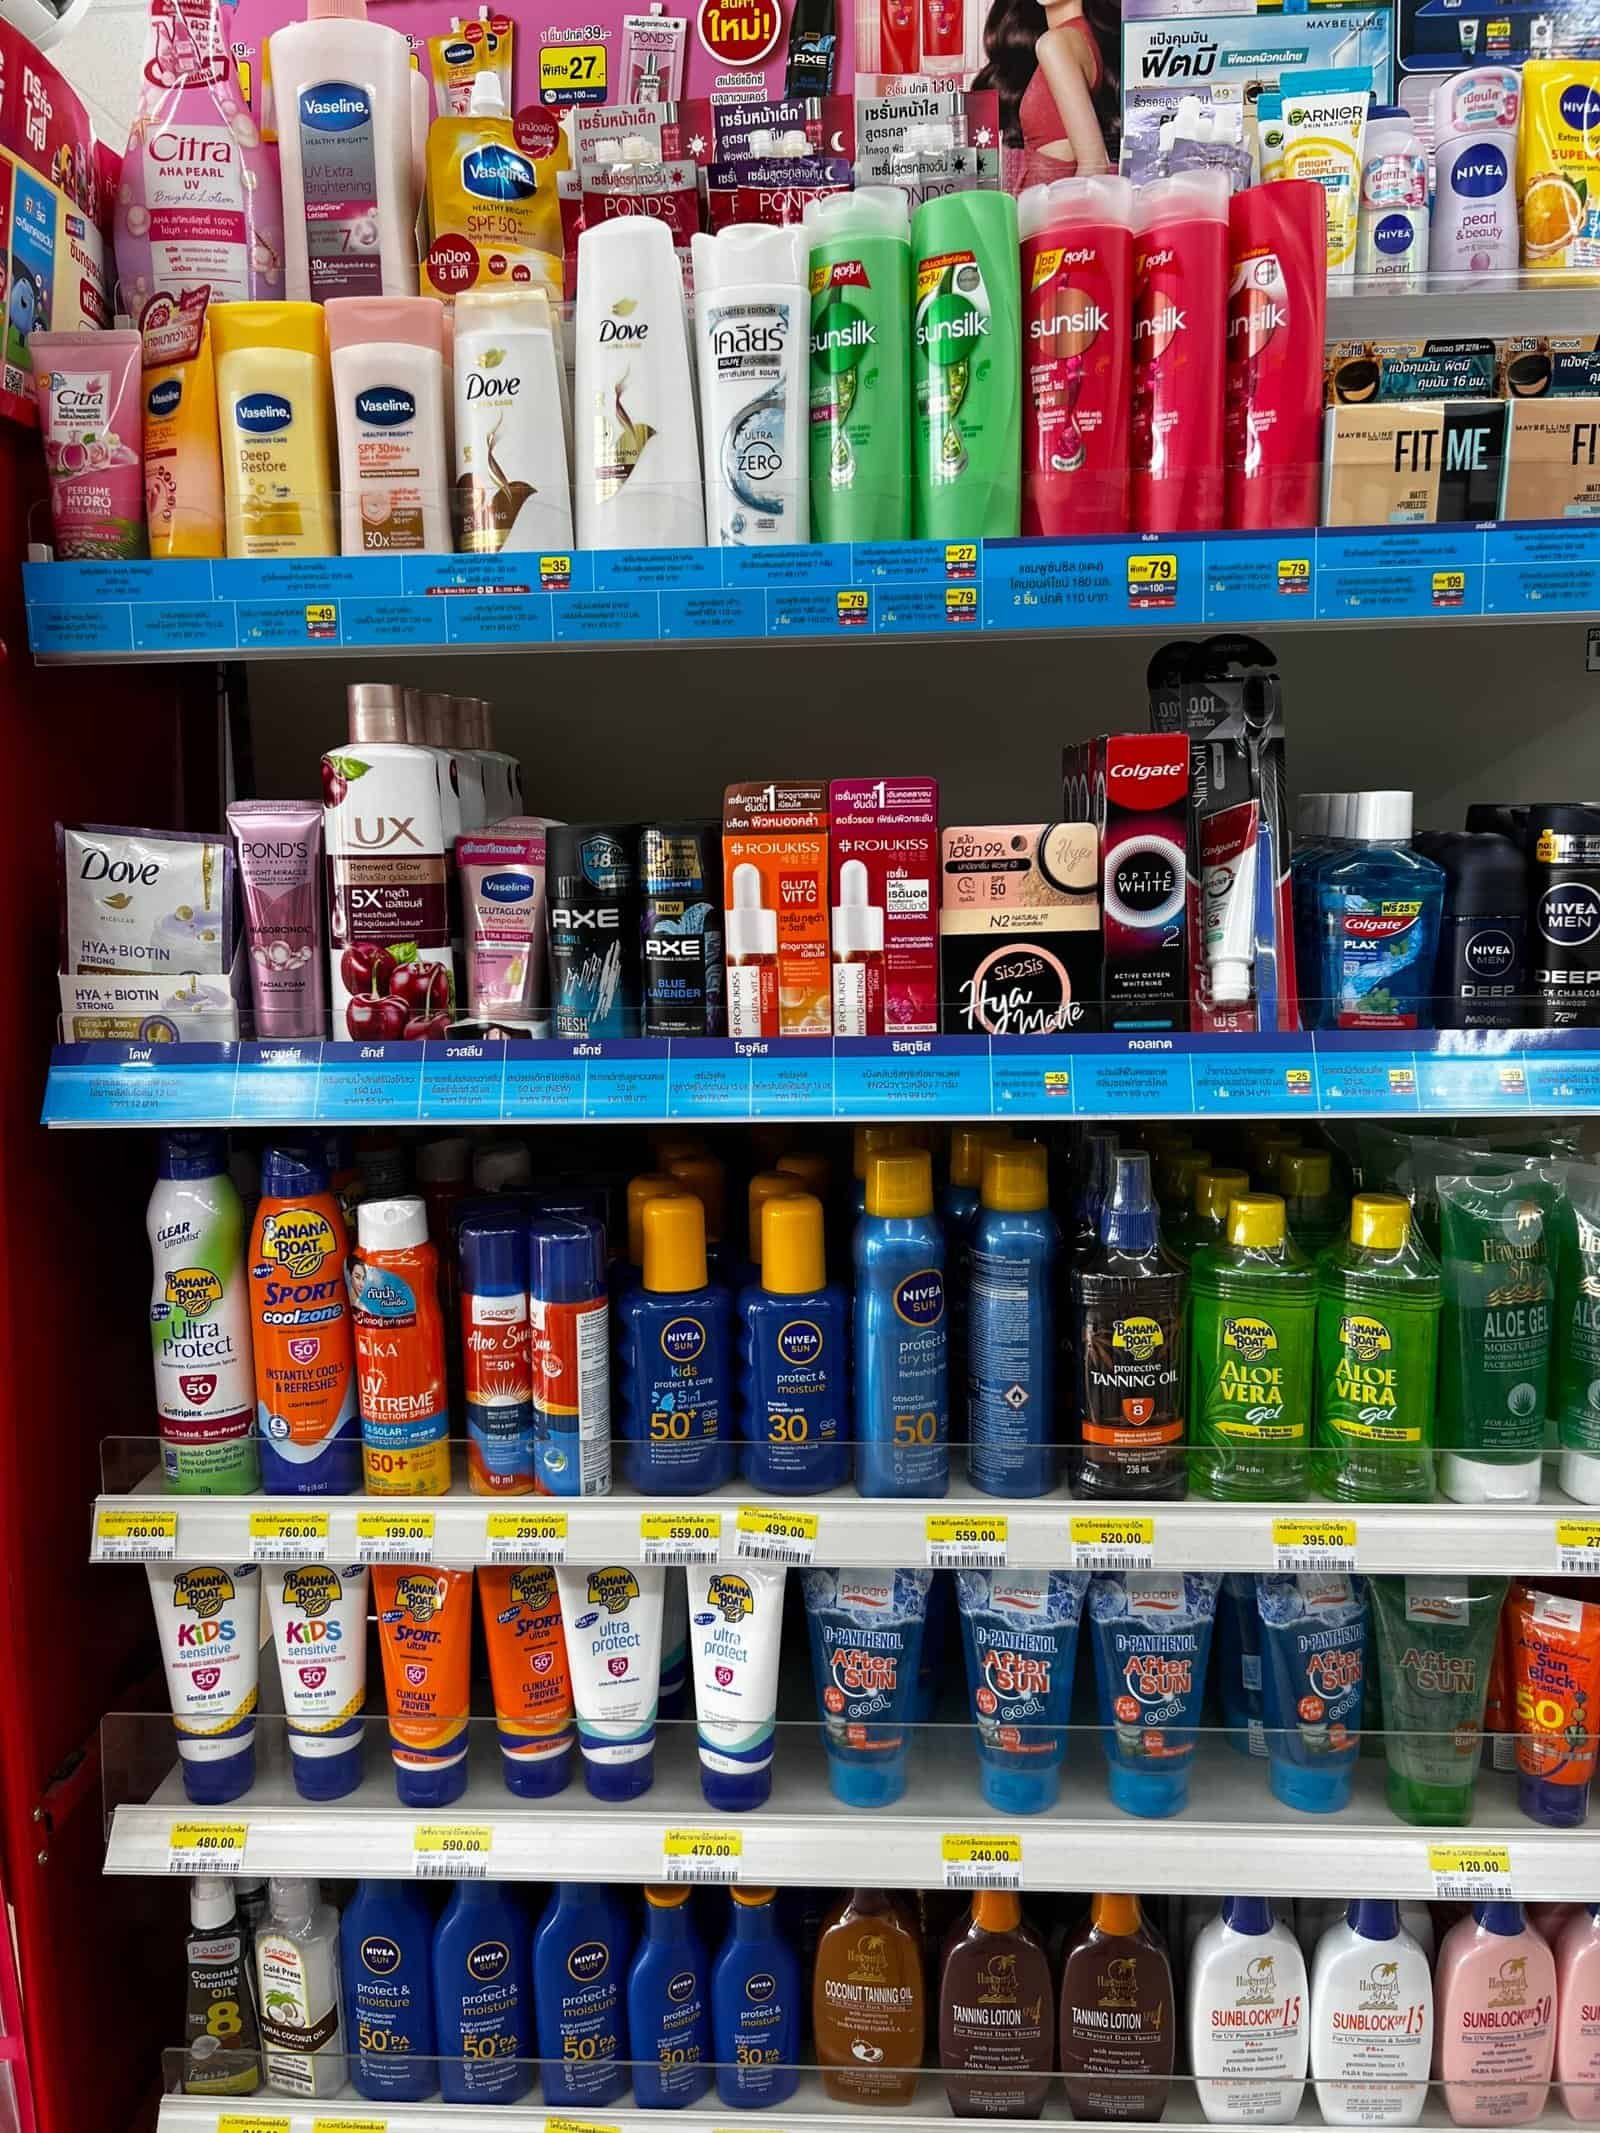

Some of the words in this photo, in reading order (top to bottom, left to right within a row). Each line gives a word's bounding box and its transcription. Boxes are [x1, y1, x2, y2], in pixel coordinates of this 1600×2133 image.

[707, 10, 770, 42] ใหม่!
[1306, 17, 1384, 31] MAYBELLINE
[633, 31, 674, 44] POND'S
[1149, 30, 1208, 47] แป้งคุมมัน
[795, 54, 827, 66] AXE
[1142, 41, 1218, 79] ฟิตมี
[542, 62, 568, 77] พิเศษ
[305, 100, 364, 115] Vaseline
[864, 98, 939, 121] เซรั่มหน้าใส
[578, 109, 656, 131] เซรั่มหน้าเด็ก
[149, 133, 232, 163] Citra
[1297, 158, 1334, 168] BRIGHT
[1297, 164, 1349, 176] COMPLETE
[159, 167, 182, 177] AHA
[185, 167, 224, 178] PEARL
[320, 166, 353, 177] Extra
[470, 162, 531, 182] Vaseline
[1456, 166, 1503, 179] NIVEA
[184, 179, 199, 190] UV
[304, 181, 372, 194] Brightening
[604, 195, 677, 217] POND'S
[1462, 212, 1497, 234] pearl
[1378, 229, 1411, 240] NIVEA
[1466, 227, 1504, 240] beauty
[430, 249, 471, 266] ปกป้อง
[439, 268, 448, 280] 5
[450, 264, 469, 281] มิติ
[747, 306, 776, 315] EDITION
[599, 320, 648, 342] Dove
[916, 312, 990, 345] sunsilk
[714, 324, 784, 354] เคลียร์
[1389, 359, 1440, 375] แป้งคุมมัน
[465, 373, 521, 400] Dove
[1417, 374, 1449, 389] คุมมัน
[1452, 375, 1466, 386] 16
[56, 389, 105, 406] Citra
[240, 406, 287, 419] Vaseline
[360, 399, 411, 412] Vaseline
[744, 430, 774, 440] ULTRA
[240, 450, 271, 463] Deep
[1394, 429, 1439, 472] FIT
[1446, 428, 1491, 471] ME
[240, 461, 287, 473] Restore
[737, 454, 783, 471] ZERO
[67, 487, 111, 497] PERFUME
[67, 495, 111, 507] HYDRO
[958, 547, 973, 560] 27
[552, 559, 567, 572] 35
[1147, 561, 1171, 579] 79
[1446, 575, 1461, 587] 109
[850, 595, 865, 607] 79
[319, 608, 333, 620] 49
[1110, 762, 1182, 779] Colgate
[751, 813, 818, 829] ผิวหมองคล้ำ
[745, 841, 820, 856] ROJUKISS
[853, 838, 929, 852] ROJUKISS
[80, 847, 160, 886] Dove
[350, 862, 393, 872] Renewed
[395, 861, 421, 871] Glow
[1118, 871, 1172, 882] OPTIC
[780, 879, 817, 891] GLUTA
[990, 882, 1006, 896] 50
[1119, 879, 1172, 893] WHITE
[478, 906, 532, 916] GLUTAGLOW
[658, 902, 680, 913] NEW
[1544, 902, 1598, 915] NIVEA
[487, 915, 524, 926] Ampoule
[552, 907, 619, 930] AXE
[887, 913, 928, 921] BAKUCHIOL
[990, 915, 1010, 928] N2
[1345, 918, 1401, 931] Colgate
[1344, 939, 1377, 949] PLAX
[1472, 945, 1511, 956] NIVEA
[80, 954, 115, 966] STRONG
[1476, 955, 1505, 964] MEN
[994, 958, 1044, 980] Sis2Sis
[658, 978, 686, 989] BLUE
[75, 989, 101, 1001] HYA
[114, 988, 159, 1001] BIOTIN
[647, 988, 701, 1000] LAVENDER
[1461, 985, 1514, 997] DEEP
[959, 978, 1033, 1021] Hya
[556, 1017, 587, 1031] FRESH
[1012, 1003, 1084, 1033] Matte
[573, 1042, 602, 1057] แอ็กซ์
[734, 1040, 768, 1055] โรจูคิส
[1128, 1037, 1173, 1050] คอลเกต
[128, 1047, 152, 1061] โดฟ
[446, 1045, 483, 1058] วาสลีน
[1054, 1073, 1066, 1083] 55
[1295, 1072, 1308, 1081] 25
[157, 1221, 191, 1242] CLEAR
[169, 1275, 217, 1290] BANANA
[176, 1288, 208, 1302] BOAT
[264, 1280, 339, 1306] SPORT
[263, 1303, 343, 1325] coolzone
[1484, 1309, 1526, 1338] ALOE
[1528, 1305, 1550, 1330] GEL
[170, 1319, 220, 1339] Ultra
[162, 1335, 233, 1357] Protect
[467, 1330, 497, 1350] Aloe
[673, 1340, 694, 1351] SUN
[671, 1365, 698, 1377] kids
[1113, 1363, 1162, 1374] protective
[1219, 1363, 1284, 1386] ALOE
[1091, 1371, 1156, 1387] TANNING
[1159, 1368, 1179, 1385] OIL
[187, 1383, 212, 1396] 50
[777, 1382, 825, 1394] moisture
[1220, 1382, 1283, 1405] VERA
[362, 1391, 434, 1411] EXTREME
[677, 1390, 701, 1403] 5in1
[1245, 1406, 1283, 1422] Gel
[768, 1415, 807, 1442] 30
[893, 1414, 937, 1447] 50
[126, 1526, 165, 1538] 760.00
[278, 1526, 317, 1538] 760.00
[385, 1527, 424, 1539] 199.00
[516, 1526, 556, 1538] 299.00
[669, 1526, 710, 1538] 559.00
[764, 1523, 805, 1538] 499.00
[955, 1530, 996, 1542] 559.00
[1100, 1532, 1141, 1544] 520.00
[1302, 1534, 1344, 1546] 395.00
[177, 1619, 236, 1647] KiDS
[599, 1621, 631, 1637] ultra
[591, 1633, 641, 1656] protect
[976, 1626, 1058, 1653] D-PANTHENOL
[179, 1644, 231, 1659] sensitive
[982, 1649, 1050, 1674] After
[1536, 1652, 1568, 1673] Sun
[997, 1670, 1050, 1693] SUN
[1528, 1667, 1575, 1691] Block
[196, 1836, 235, 1849] 480.00
[442, 1839, 480, 1851] 590.00
[691, 1844, 730, 1857] 470.00
[970, 1849, 1009, 1862] 240.00
[1458, 1861, 1499, 1873] 120.00
[191, 1966, 239, 1980] Coconut
[825, 1979, 862, 2003] COCONUT
[864, 1984, 899, 2004] TANNING
[357, 1994, 409, 2008] moisture
[206, 2000, 242, 2037] 8
[990, 2006, 1021, 2025] LOTION
[1211, 2009, 1272, 2027] SUNBLOCK
